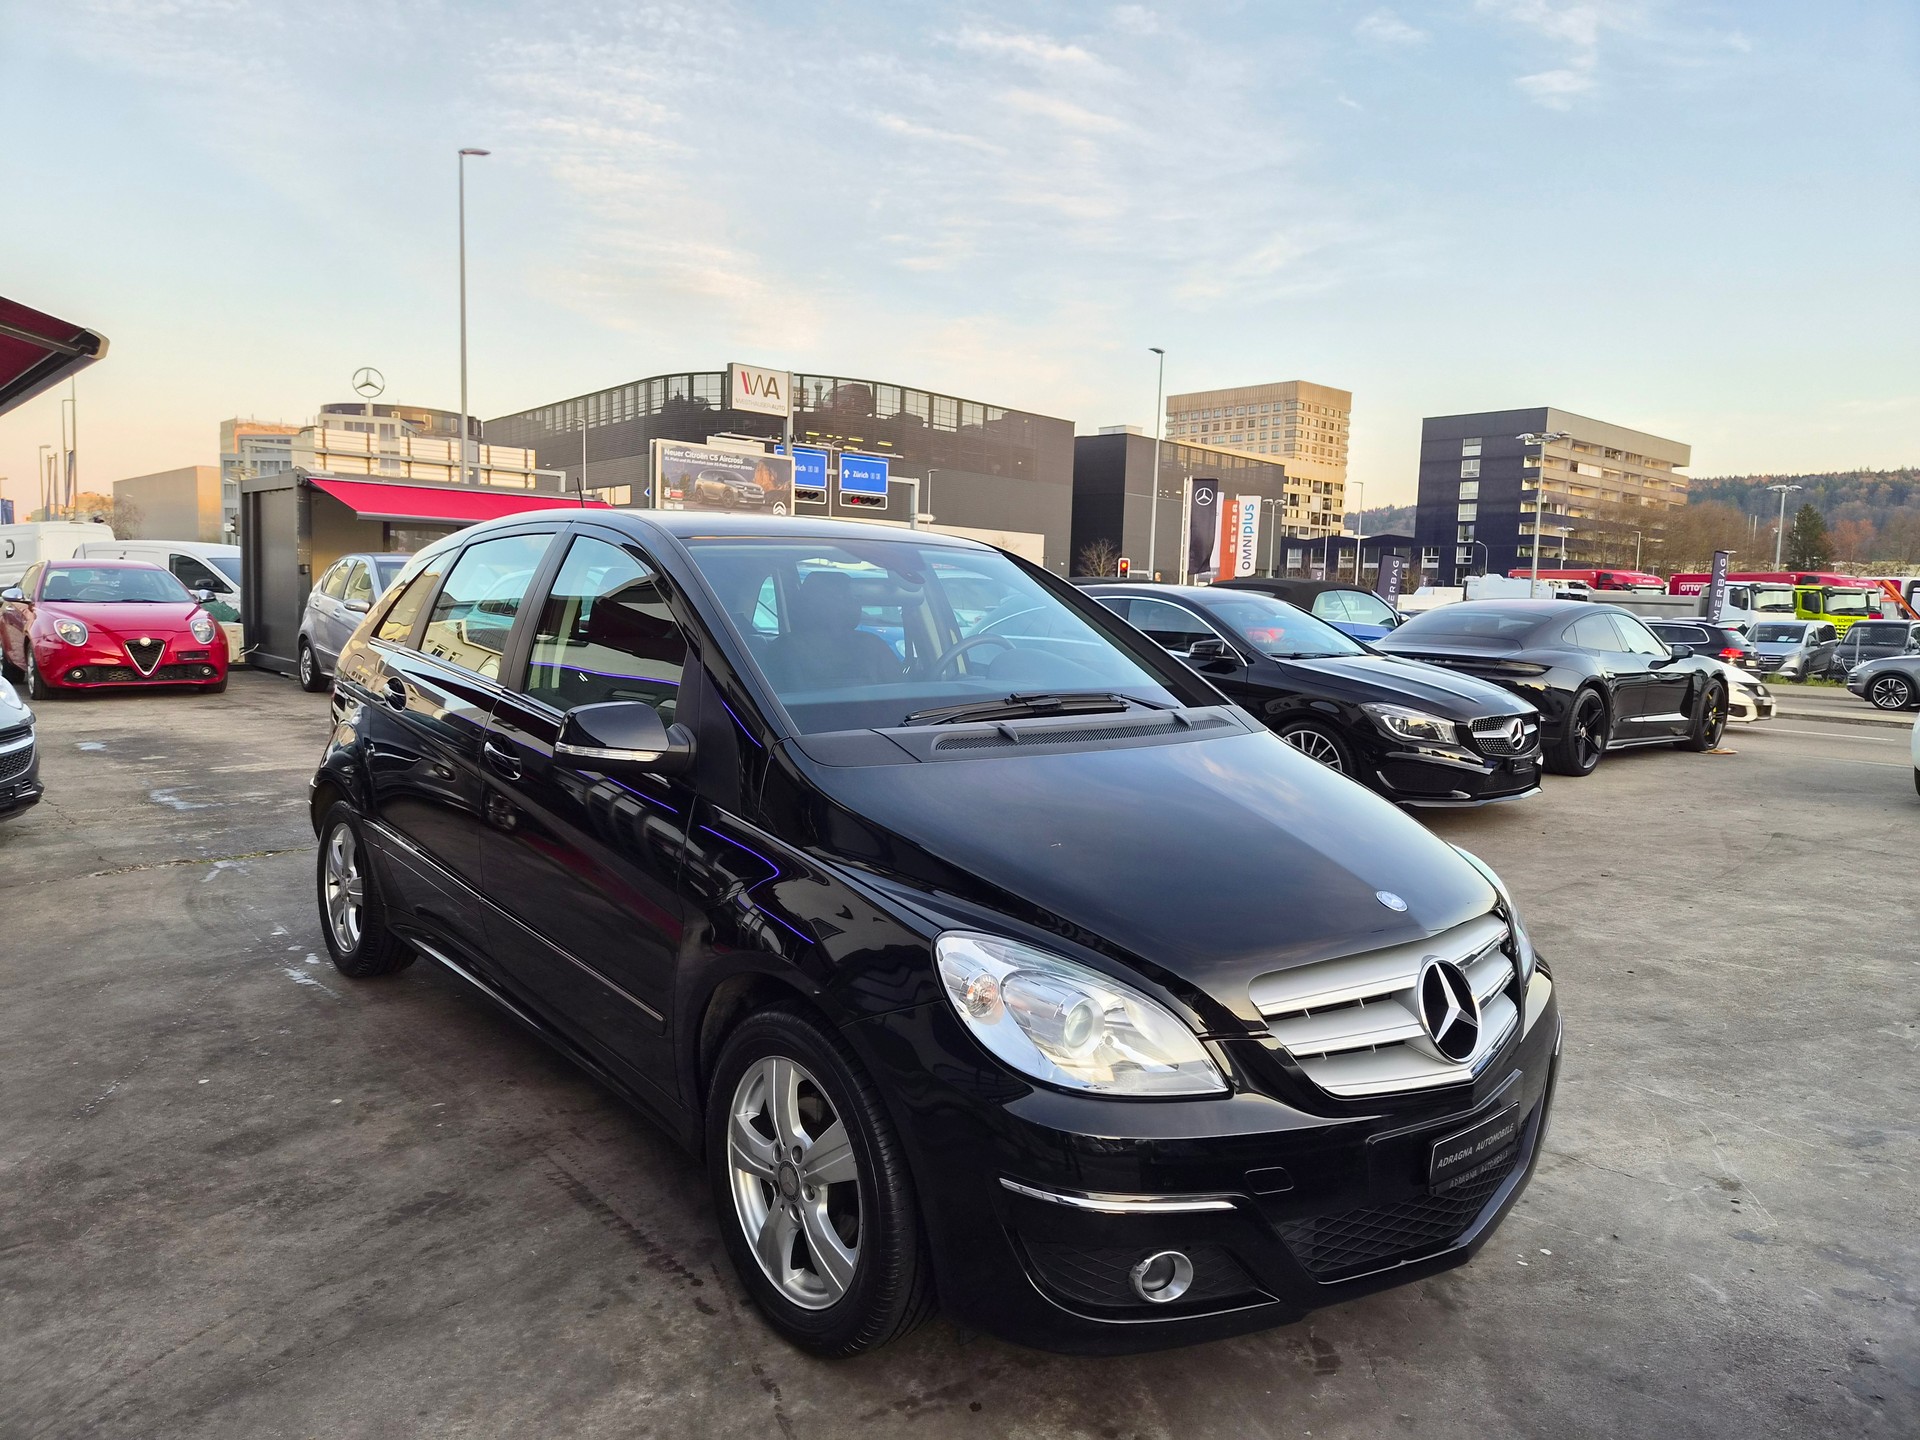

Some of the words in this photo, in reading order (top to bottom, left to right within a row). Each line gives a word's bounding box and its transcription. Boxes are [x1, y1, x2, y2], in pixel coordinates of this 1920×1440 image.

[664, 448, 684, 457] Neuer
[685, 450, 708, 460] Citroën
[709, 454, 719, 462] C5
[719, 455, 744, 465] Aircross
[853, 470, 869, 479] Zürich
[1229, 503, 1238, 554] SETRA
[1713, 558, 1726, 621] MERBAG
[1437, 1146, 1473, 1169] ADRAGNA
[1475, 1123, 1514, 1153] AUTOMOBILE
